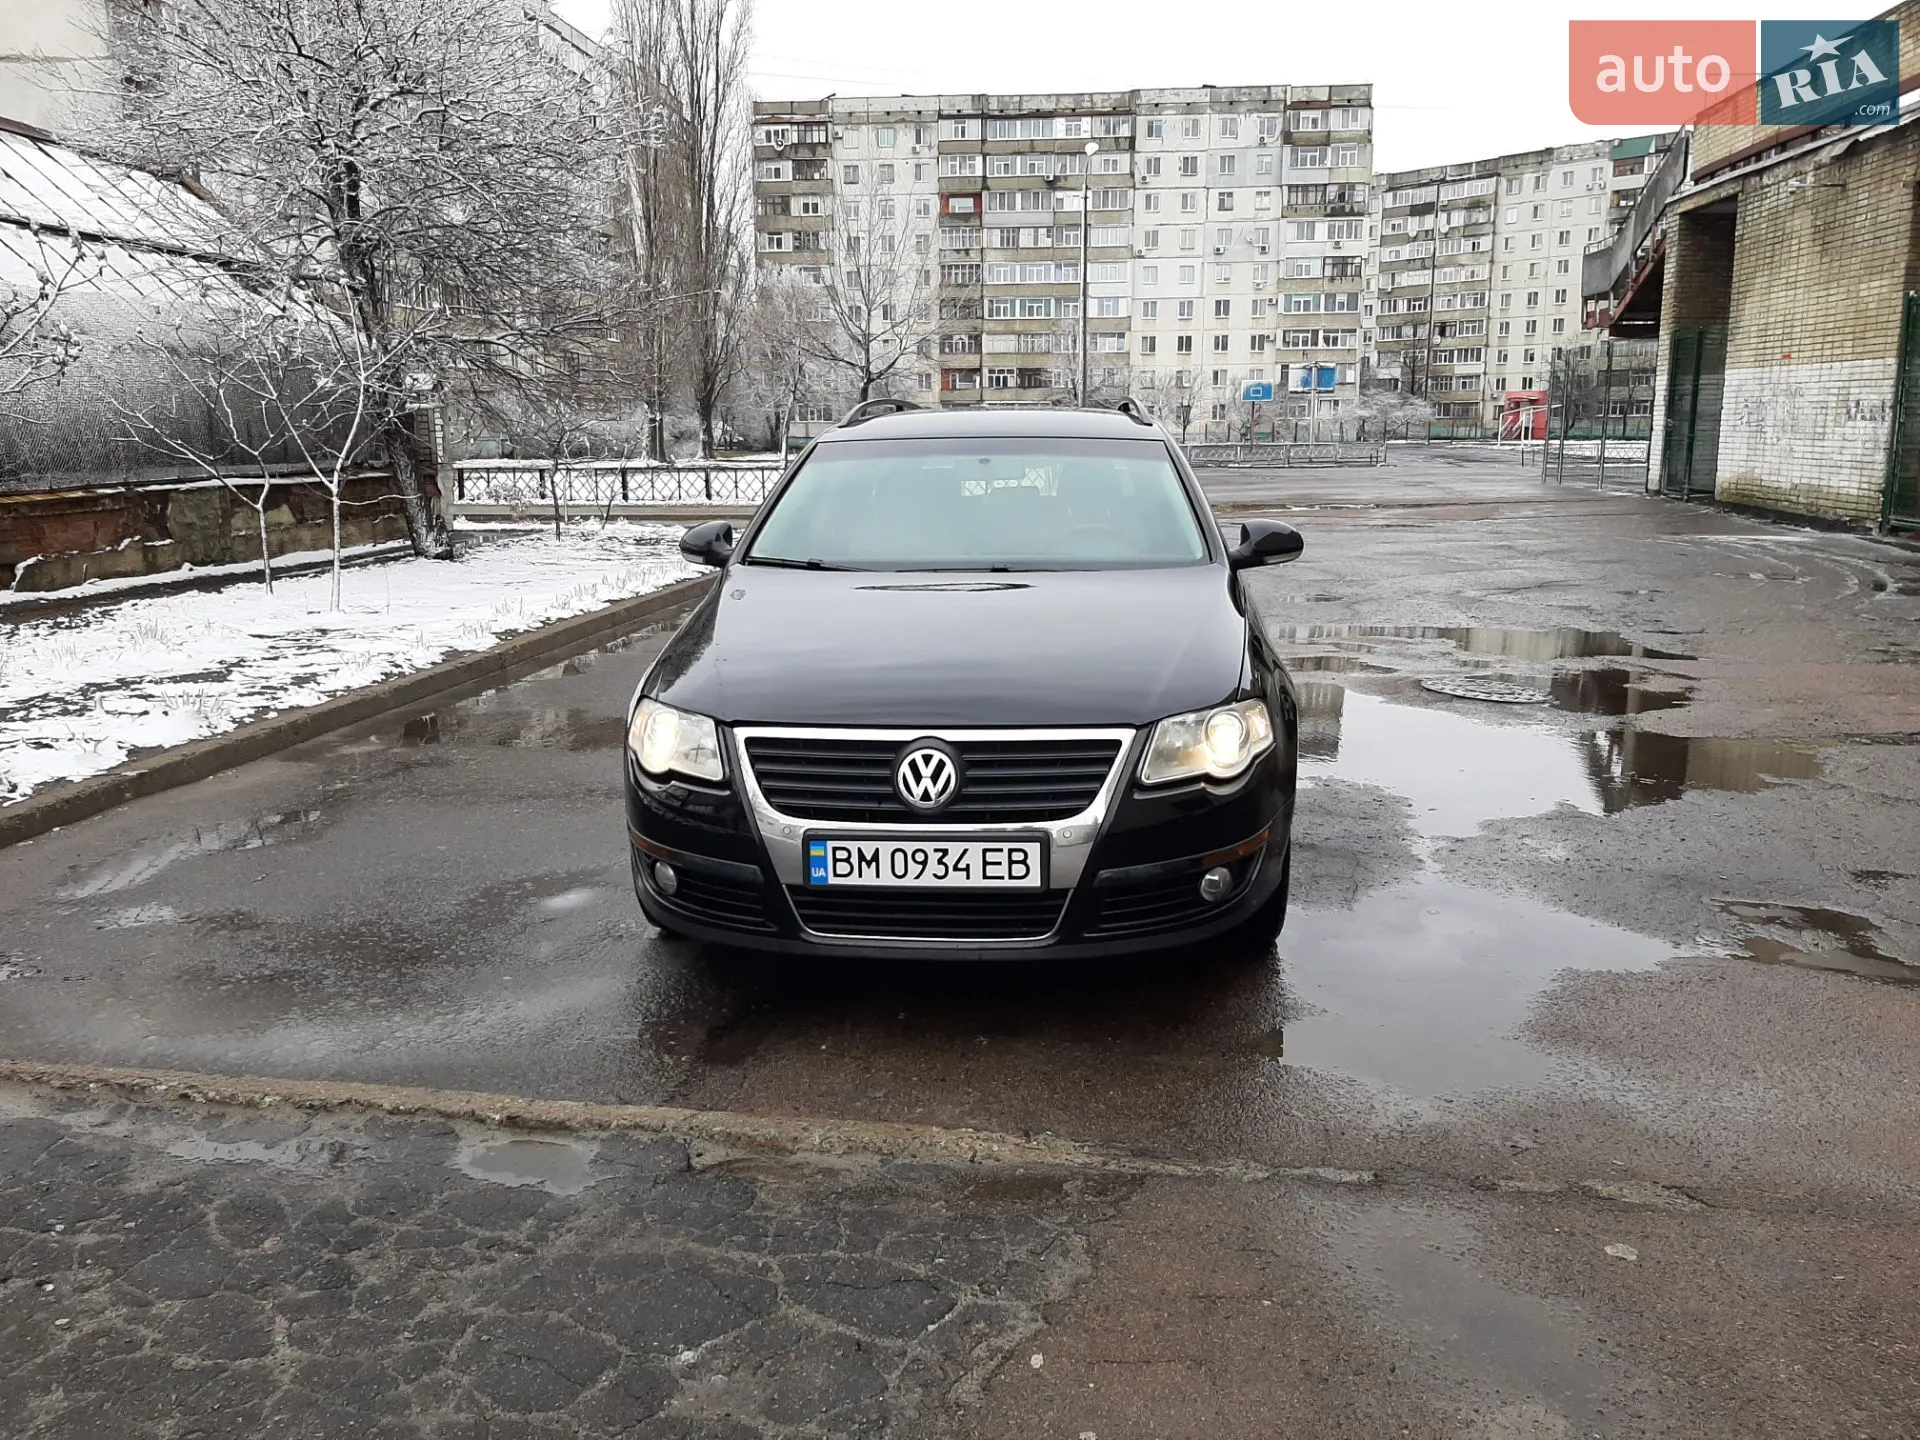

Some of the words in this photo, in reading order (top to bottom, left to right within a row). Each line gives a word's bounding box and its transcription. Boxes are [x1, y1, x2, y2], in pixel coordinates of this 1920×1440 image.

[811, 867, 826, 877] UA
[831, 846, 881, 879] BM
[890, 847, 971, 880] 0934
[981, 847, 1031, 880] EB
